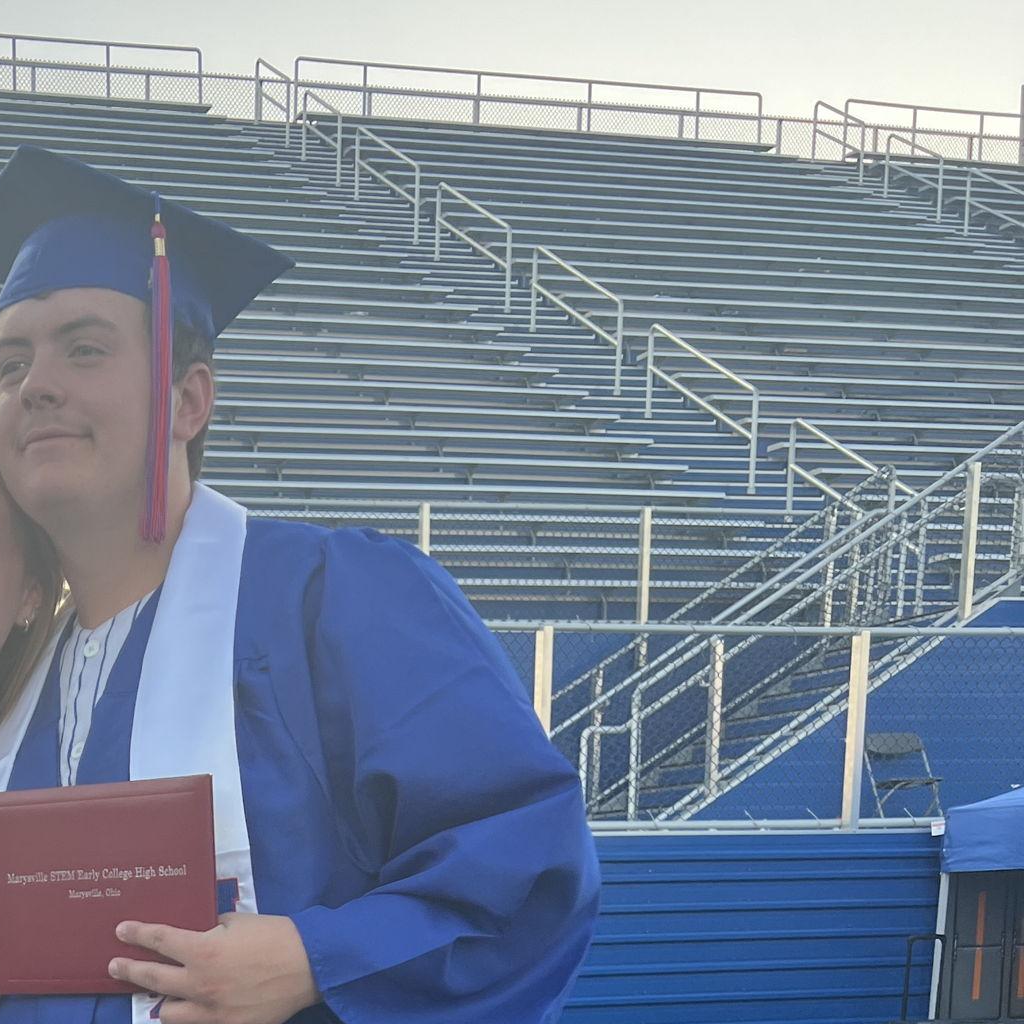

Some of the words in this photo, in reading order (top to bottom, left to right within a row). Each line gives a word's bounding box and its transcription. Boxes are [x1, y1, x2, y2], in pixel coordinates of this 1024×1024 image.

[7, 872, 48, 886] Marysville
[50, 869, 75, 882] STEM
[77, 868, 100, 882] Early
[102, 868, 133, 881] College
[135, 866, 156, 880] High
[158, 864, 187, 877] School
[105, 888, 121, 898] Ohio
